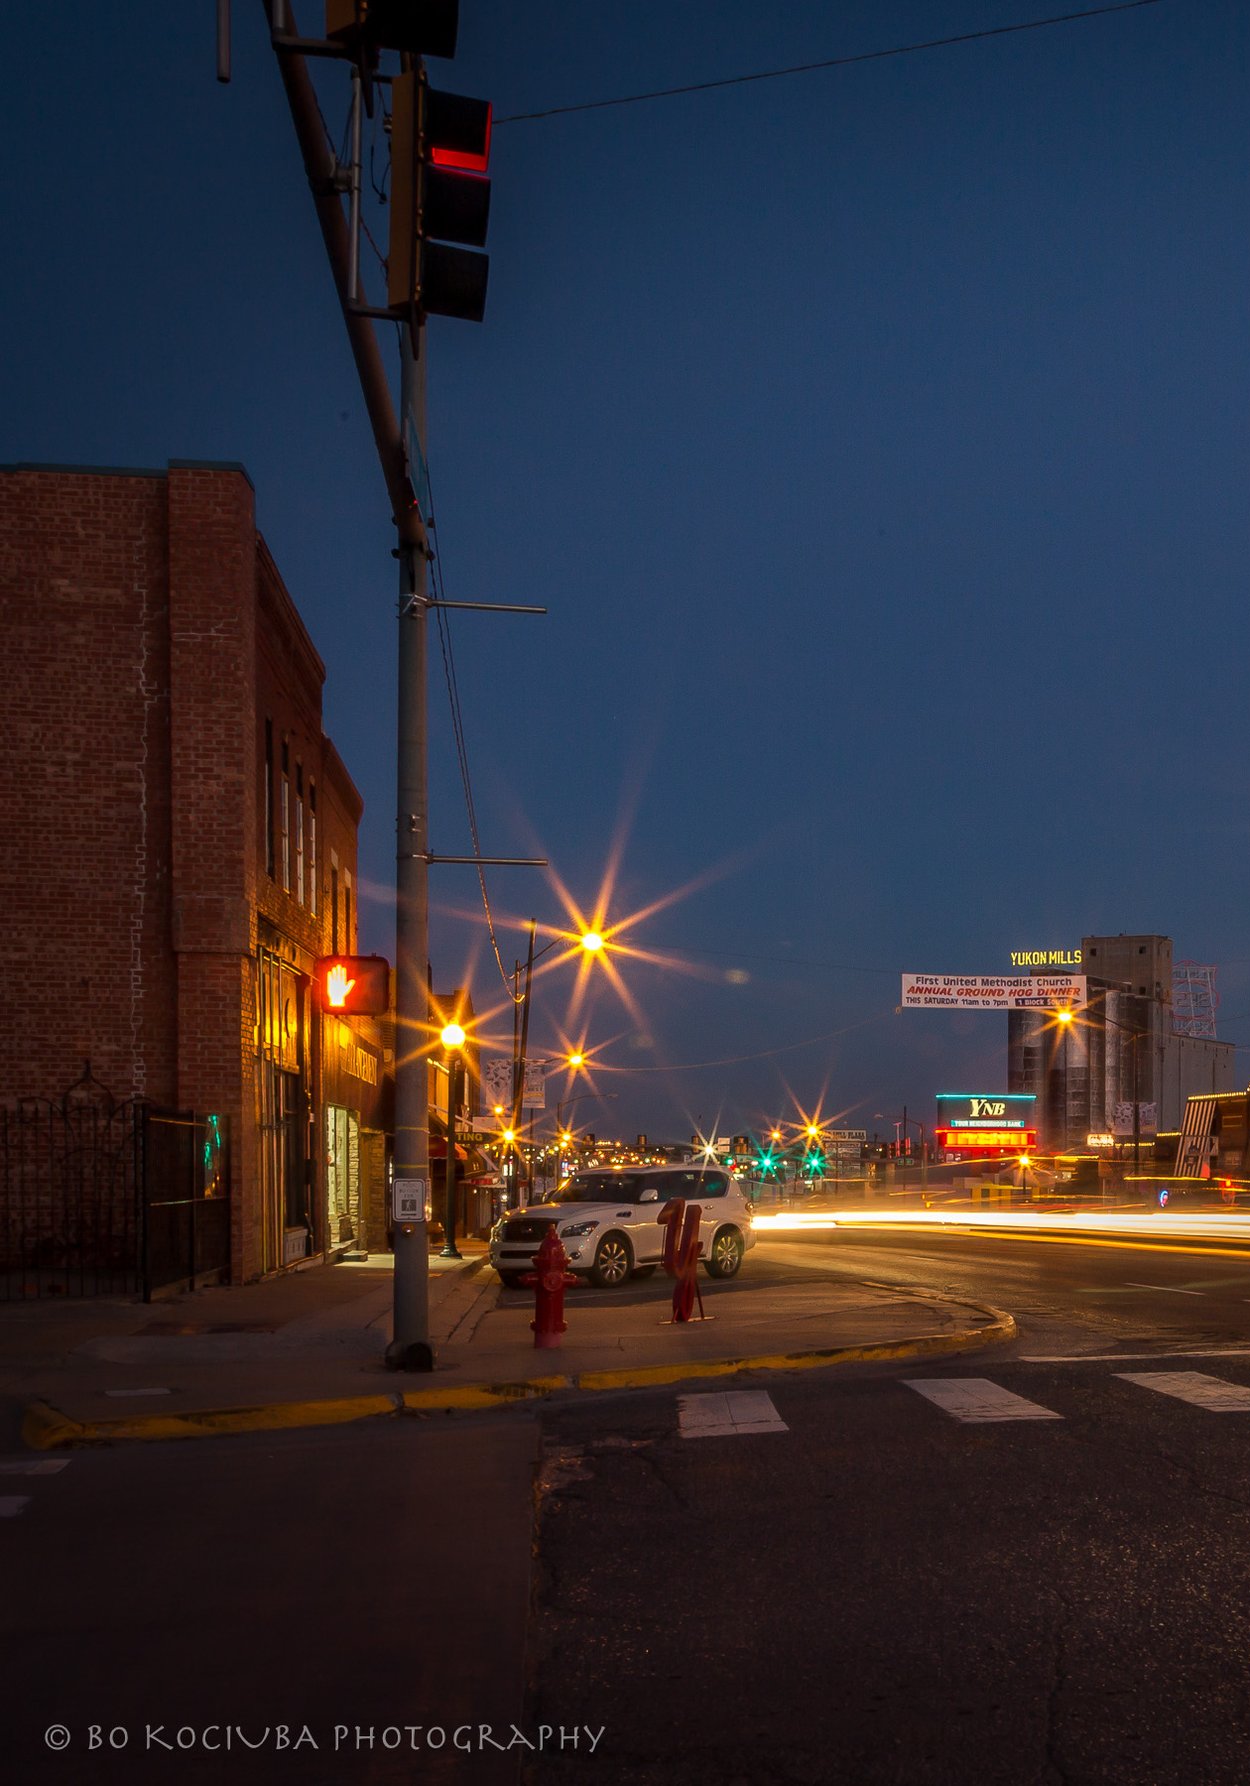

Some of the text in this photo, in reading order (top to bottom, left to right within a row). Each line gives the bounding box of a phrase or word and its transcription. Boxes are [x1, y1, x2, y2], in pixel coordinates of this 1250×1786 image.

[1011, 950, 1082, 966] YUKON MILLS
[915, 976, 1072, 987] First United Methodist Church
[907, 985, 1081, 997] ANNUAL GROUND HOG DINNER
[906, 996, 921, 1004] THIS
[924, 996, 958, 1005] SATURDAY
[961, 997, 979, 1006] 11am
[992, 999, 1008, 1008] 7pm
[1024, 998, 1045, 1006] Block
[969, 1098, 1006, 1117] YNB
